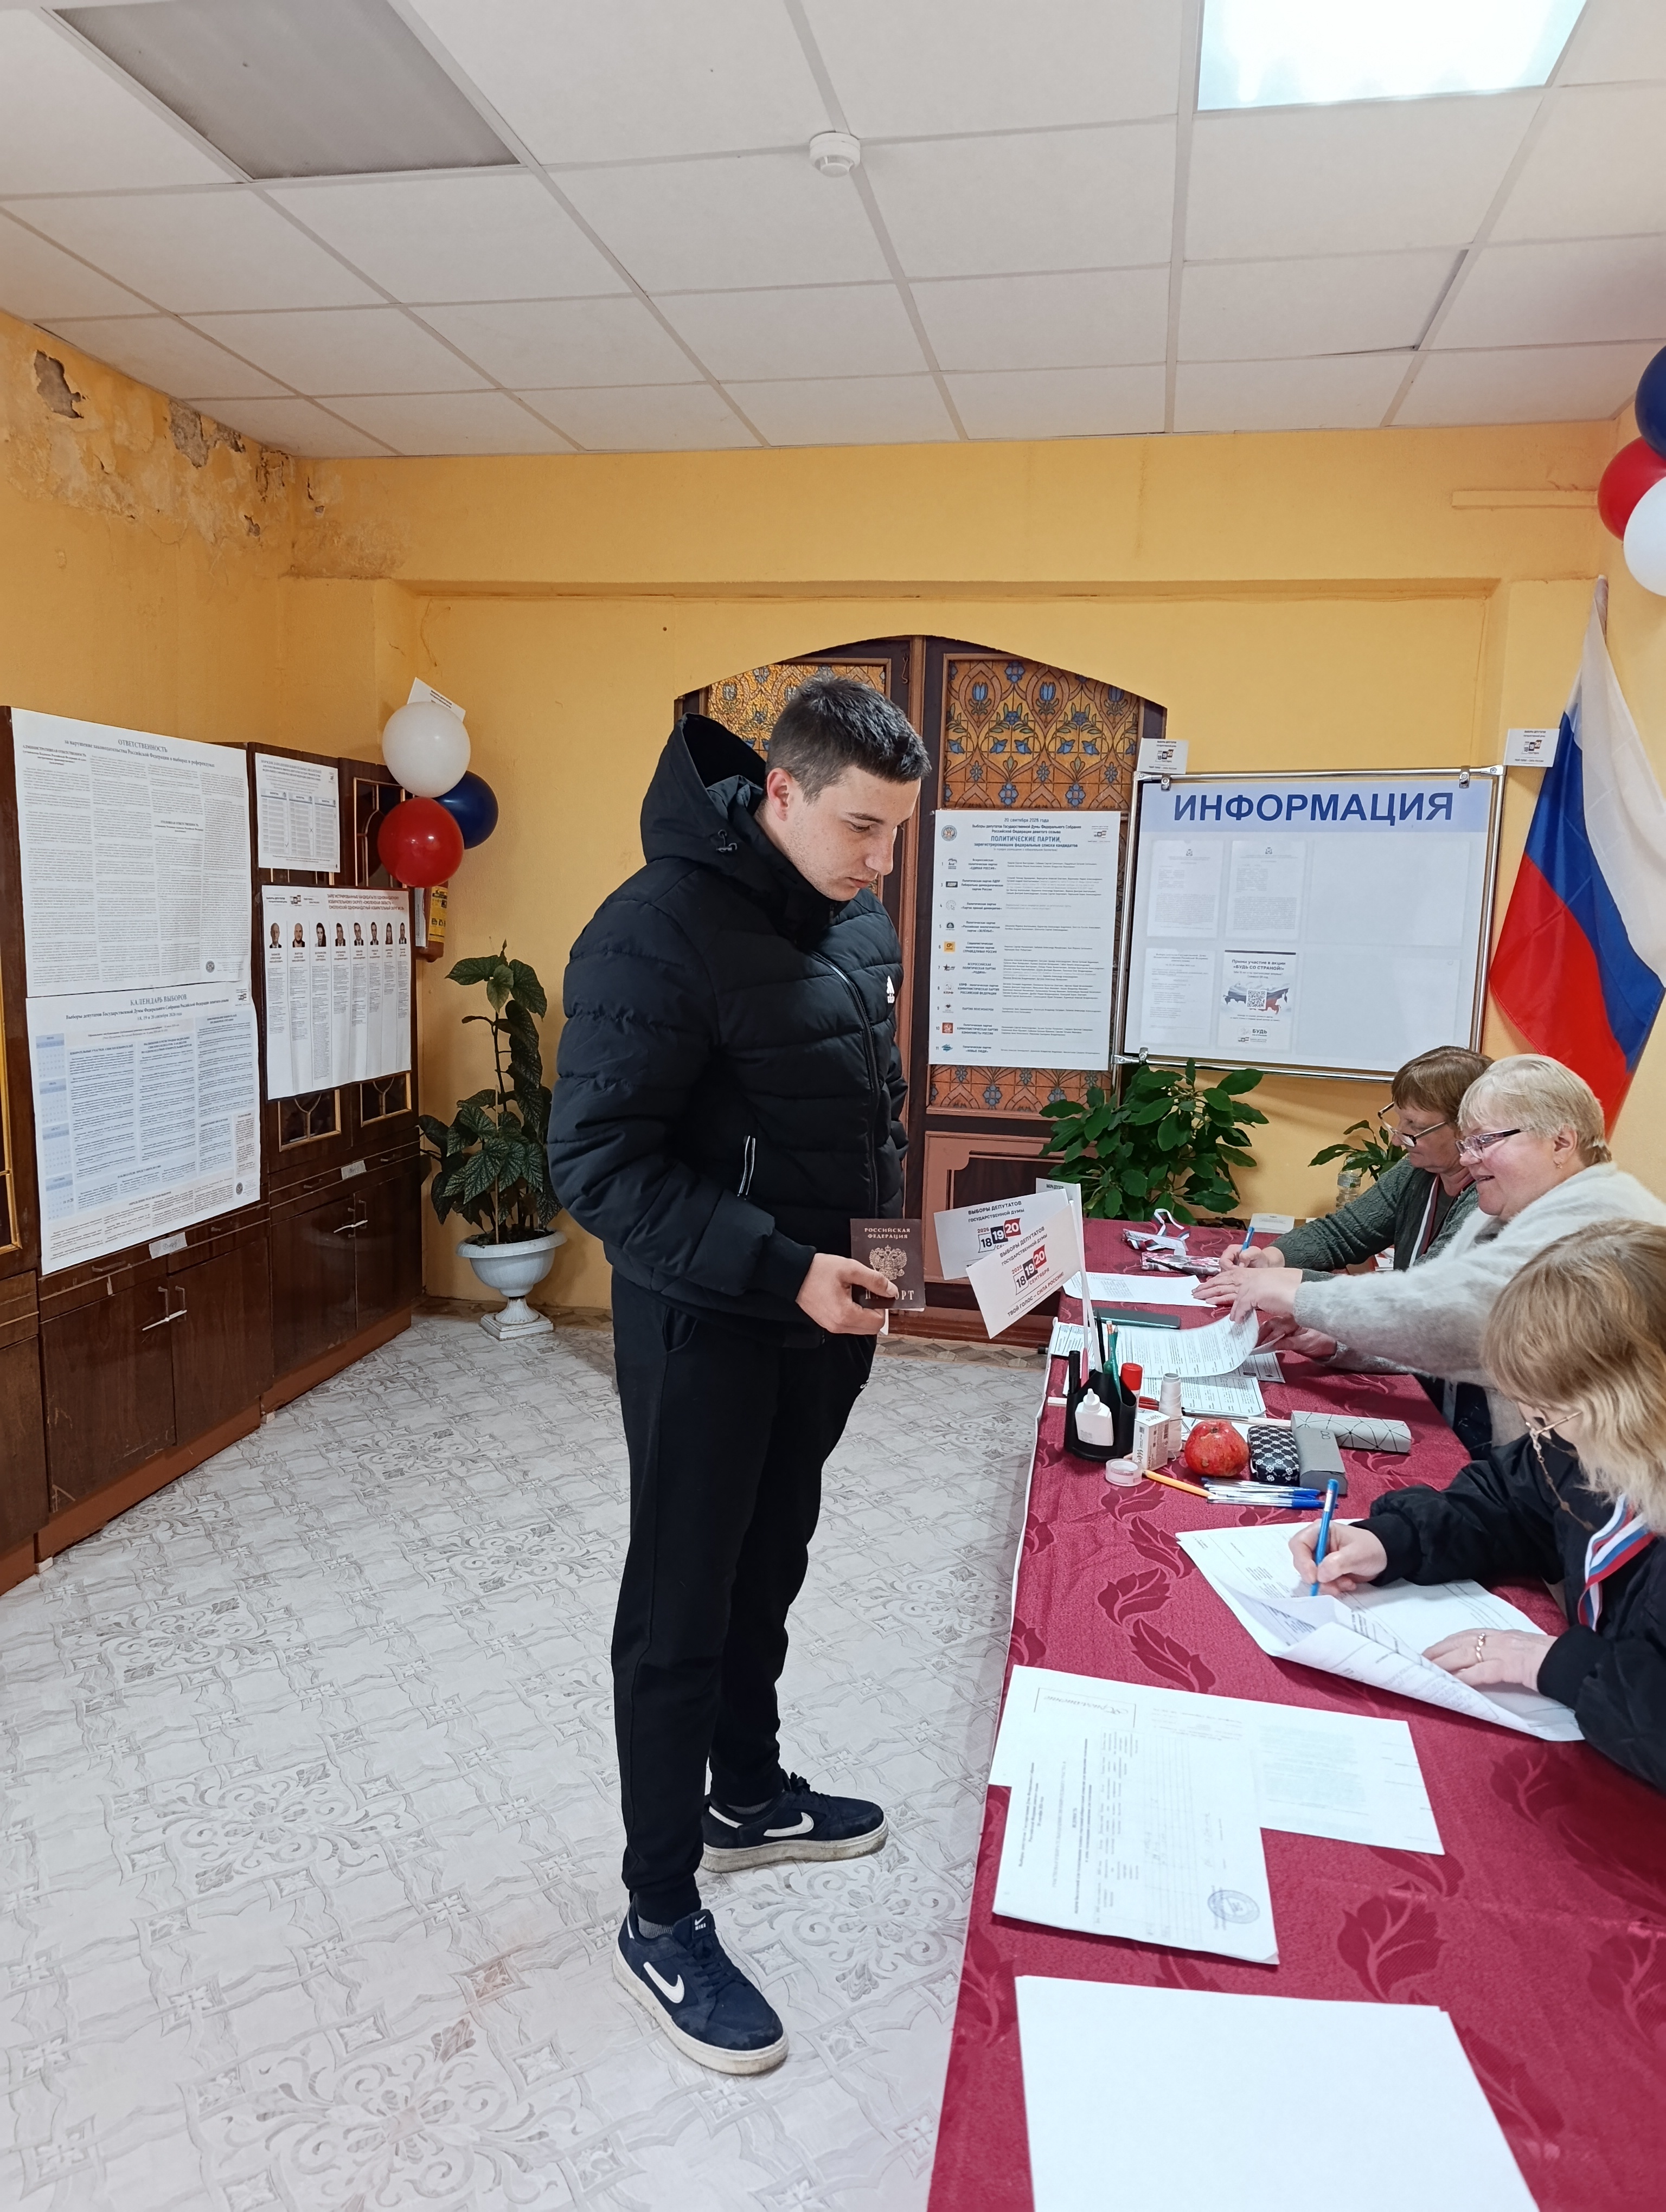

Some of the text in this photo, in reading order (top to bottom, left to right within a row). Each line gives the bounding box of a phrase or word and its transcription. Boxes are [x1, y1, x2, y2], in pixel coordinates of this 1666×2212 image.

[118, 740, 168, 752] ОТВЕТСТВЕННОСТЬ
[1174, 793, 1453, 826] ИНФОРМАЦИЯ
[130, 996, 163, 1006] КАЛЕНДАРЬ
[968, 1201, 1022, 1215] ВЫБОРЫ ДЕПУТАТОВ
[968, 1211, 1010, 1223] ГОСУДАРСТВЕННОЙ
[981, 1238, 992, 1248] 18
[992, 1230, 1004, 1240] 19
[1005, 1223, 1019, 1233] 20
[999, 1226, 1045, 1258] ВЫБОРЫ ДЕПУТАТОВ
[1002, 1234, 1048, 1266] ГОСУДАРСТВЕННОЙ ДУМЫ
[1011, 1265, 1022, 1274] 2026
[1016, 1250, 1045, 1288] 18 19 20
[1029, 1268, 1049, 1285] СЕНТЯБРЯ
[865, 1289, 914, 1300] ПОРТ
[1007, 1306, 1020, 1316] ТВОЙ
[1020, 1296, 1033, 1309] ГОЛОС
[1037, 1285, 1048, 1295] СИЛА
[1048, 1272, 1064, 1288] РОССИИ!
